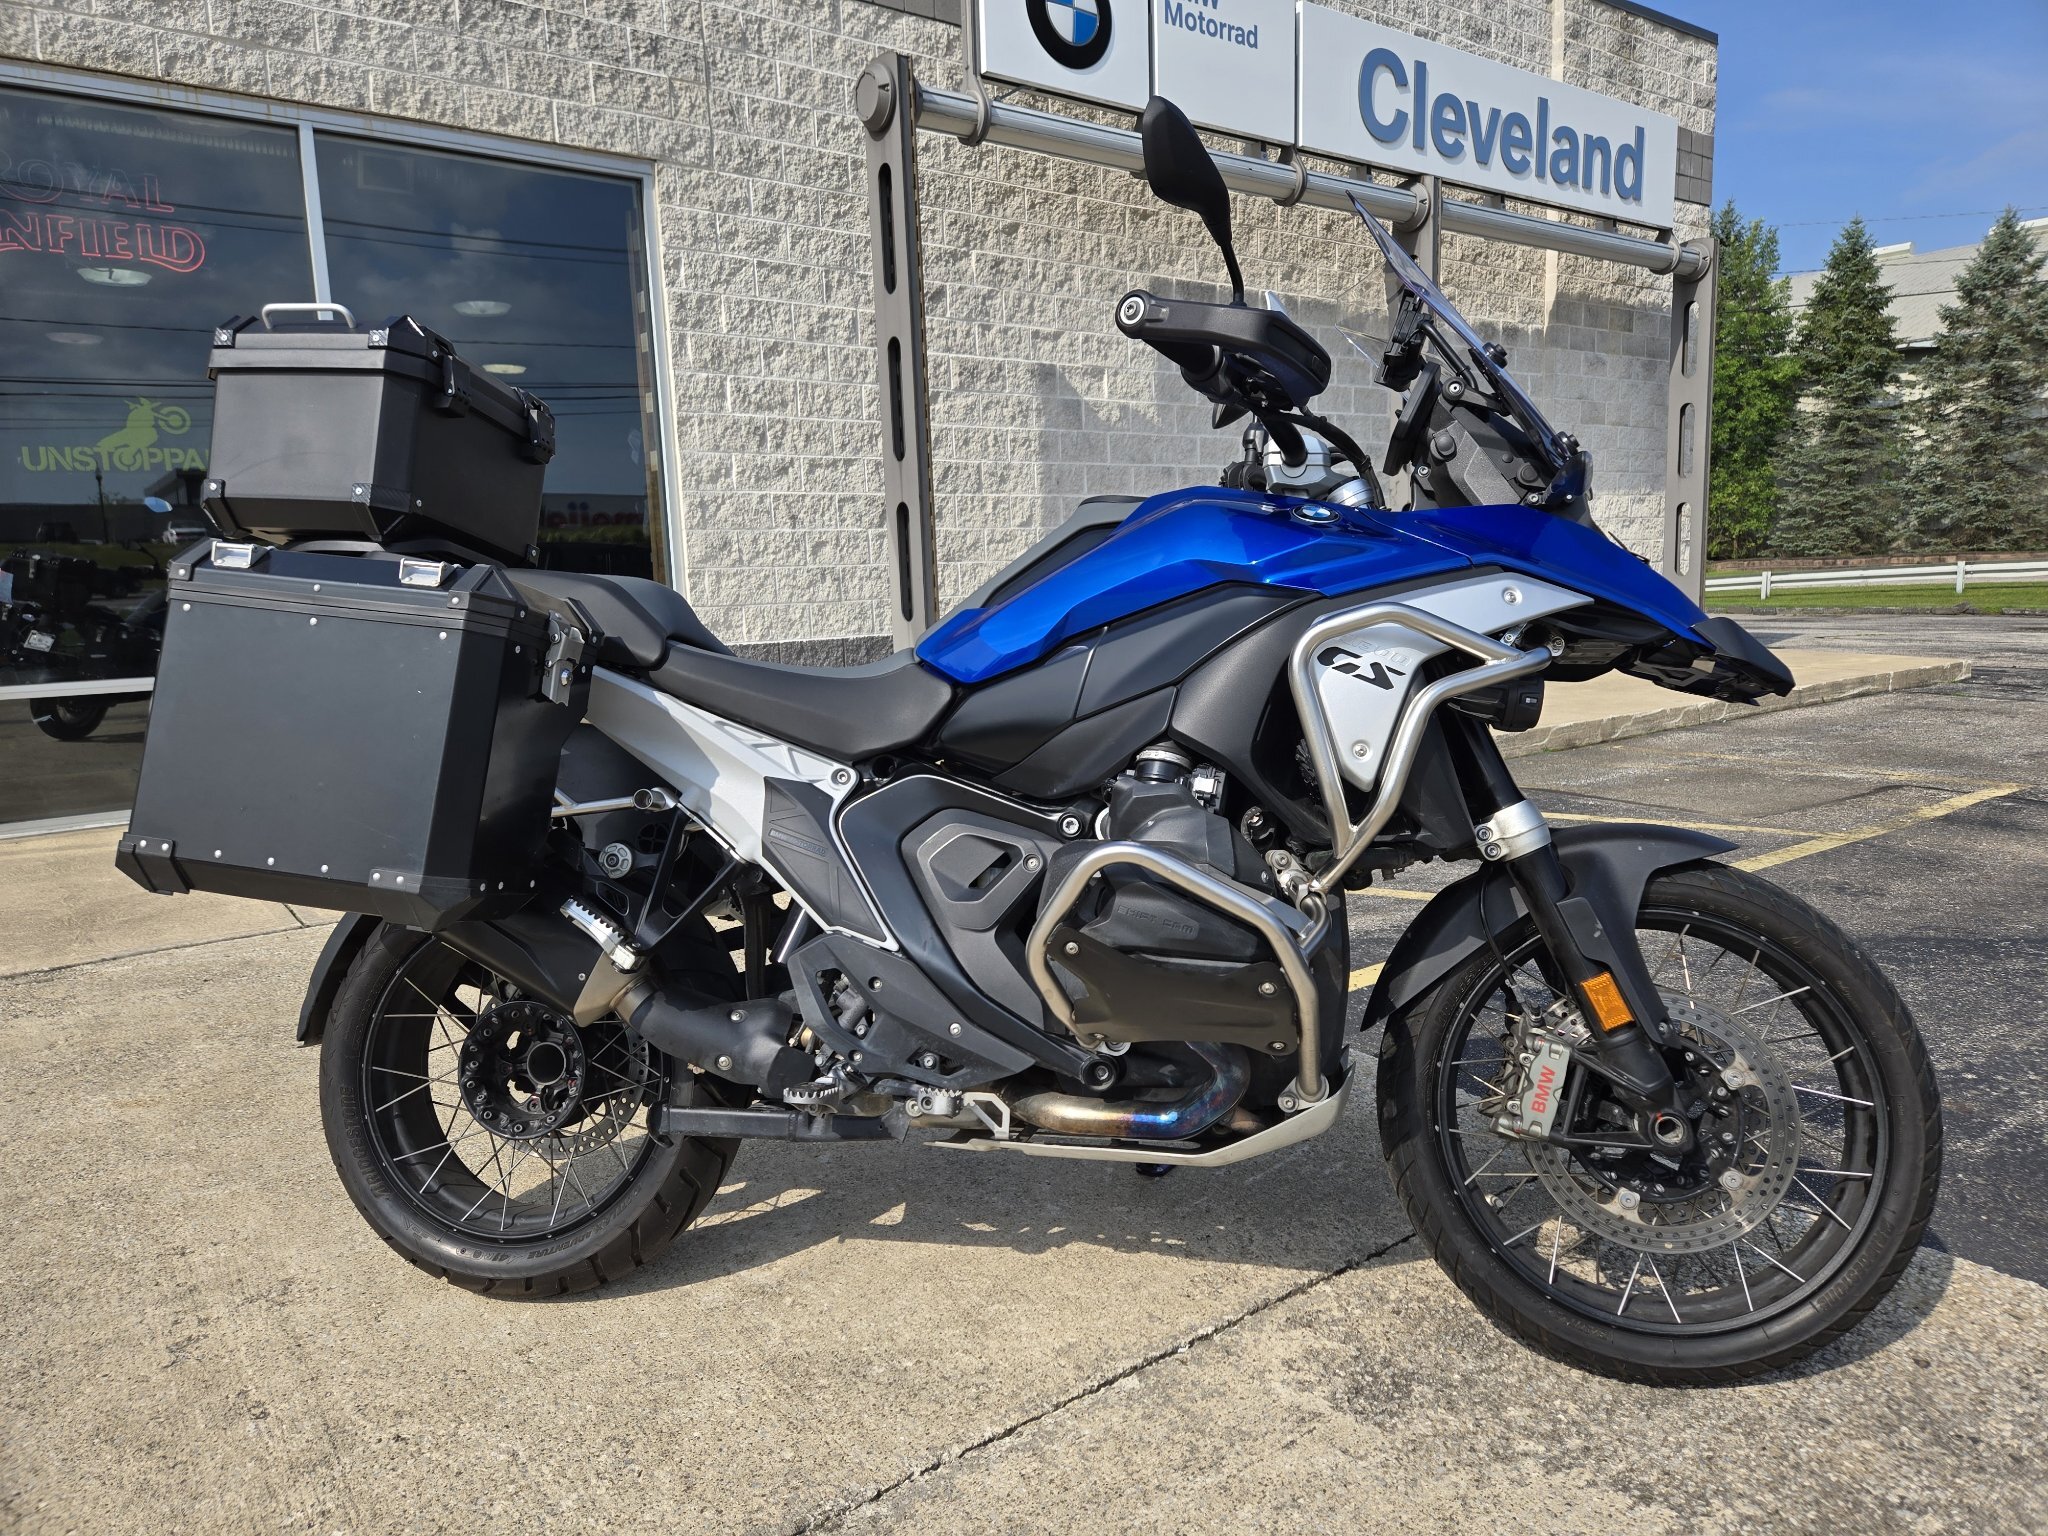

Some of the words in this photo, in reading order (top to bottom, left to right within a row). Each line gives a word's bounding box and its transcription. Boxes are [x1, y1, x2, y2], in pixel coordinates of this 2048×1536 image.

[1165, 0, 1258, 50] Motorrad
[1358, 48, 1645, 201] Cleveland
[0, 151, 175, 213] OYAL
[0, 208, 206, 273] NFIELD
[21, 446, 209, 472] UNSTOPPA
[1317, 646, 1407, 691] GS
[1530, 1064, 1557, 1115] BMW
